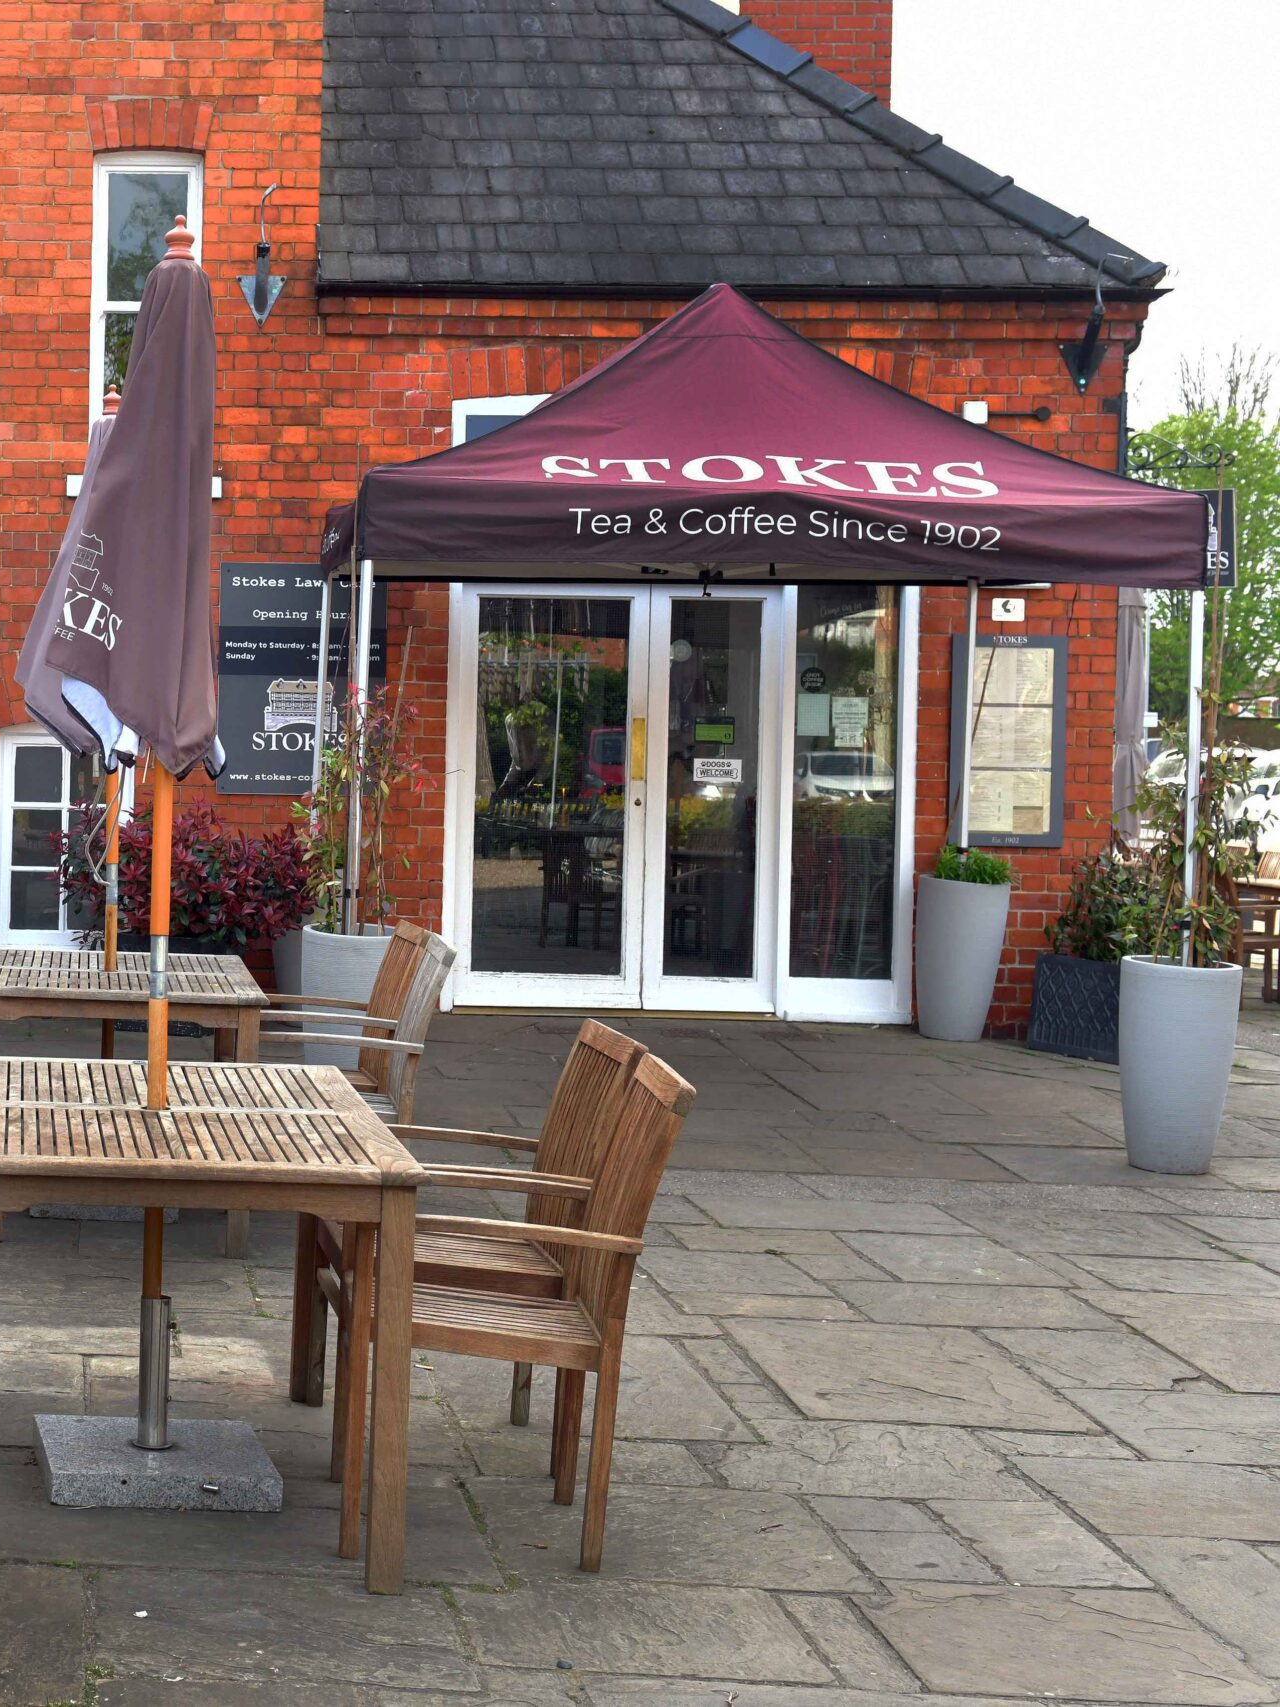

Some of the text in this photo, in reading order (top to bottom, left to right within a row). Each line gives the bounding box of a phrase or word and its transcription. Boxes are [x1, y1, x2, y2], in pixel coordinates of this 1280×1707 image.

[541, 454, 1000, 498] STOKES
[568, 506, 1001, 552] Tea & Coffee Since 1902
[232, 576, 286, 587] Stokes
[294, 577, 324, 588] Law
[62, 587, 123, 651] KES
[252, 609, 353, 621] Opening Hur
[53, 624, 76, 641] FEE
[225, 641, 257, 649] Monday
[269, 641, 305, 650] Saturday
[225, 652, 256, 661] Sunday
